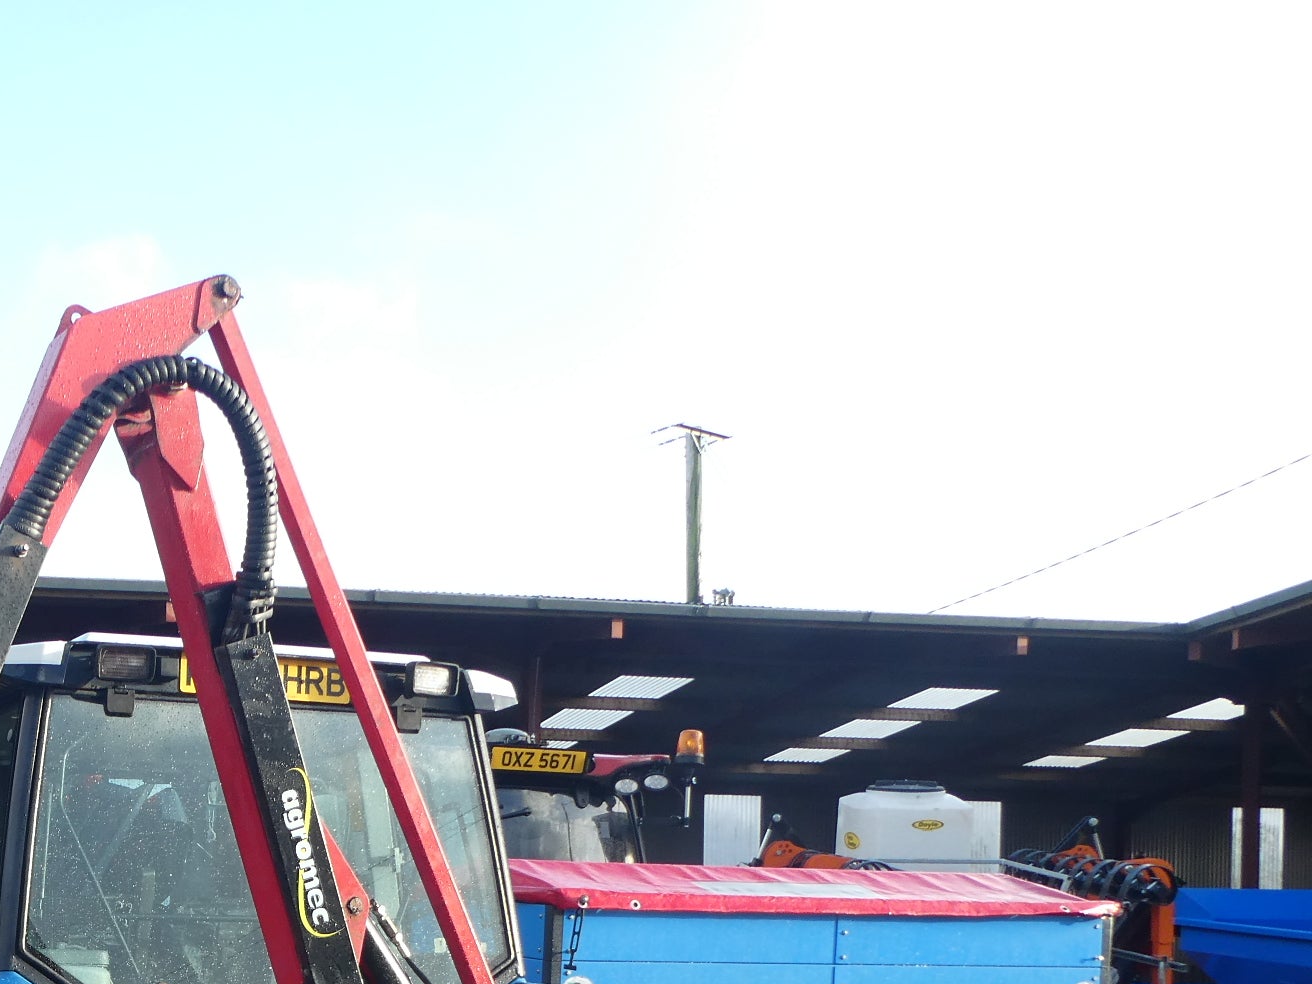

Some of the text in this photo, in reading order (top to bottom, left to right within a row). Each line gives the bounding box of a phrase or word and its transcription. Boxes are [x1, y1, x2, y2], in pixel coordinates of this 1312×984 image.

[283, 663, 346, 697] HRB
[501, 750, 577, 770] OXZ 5671
[281, 788, 330, 926] agromec
